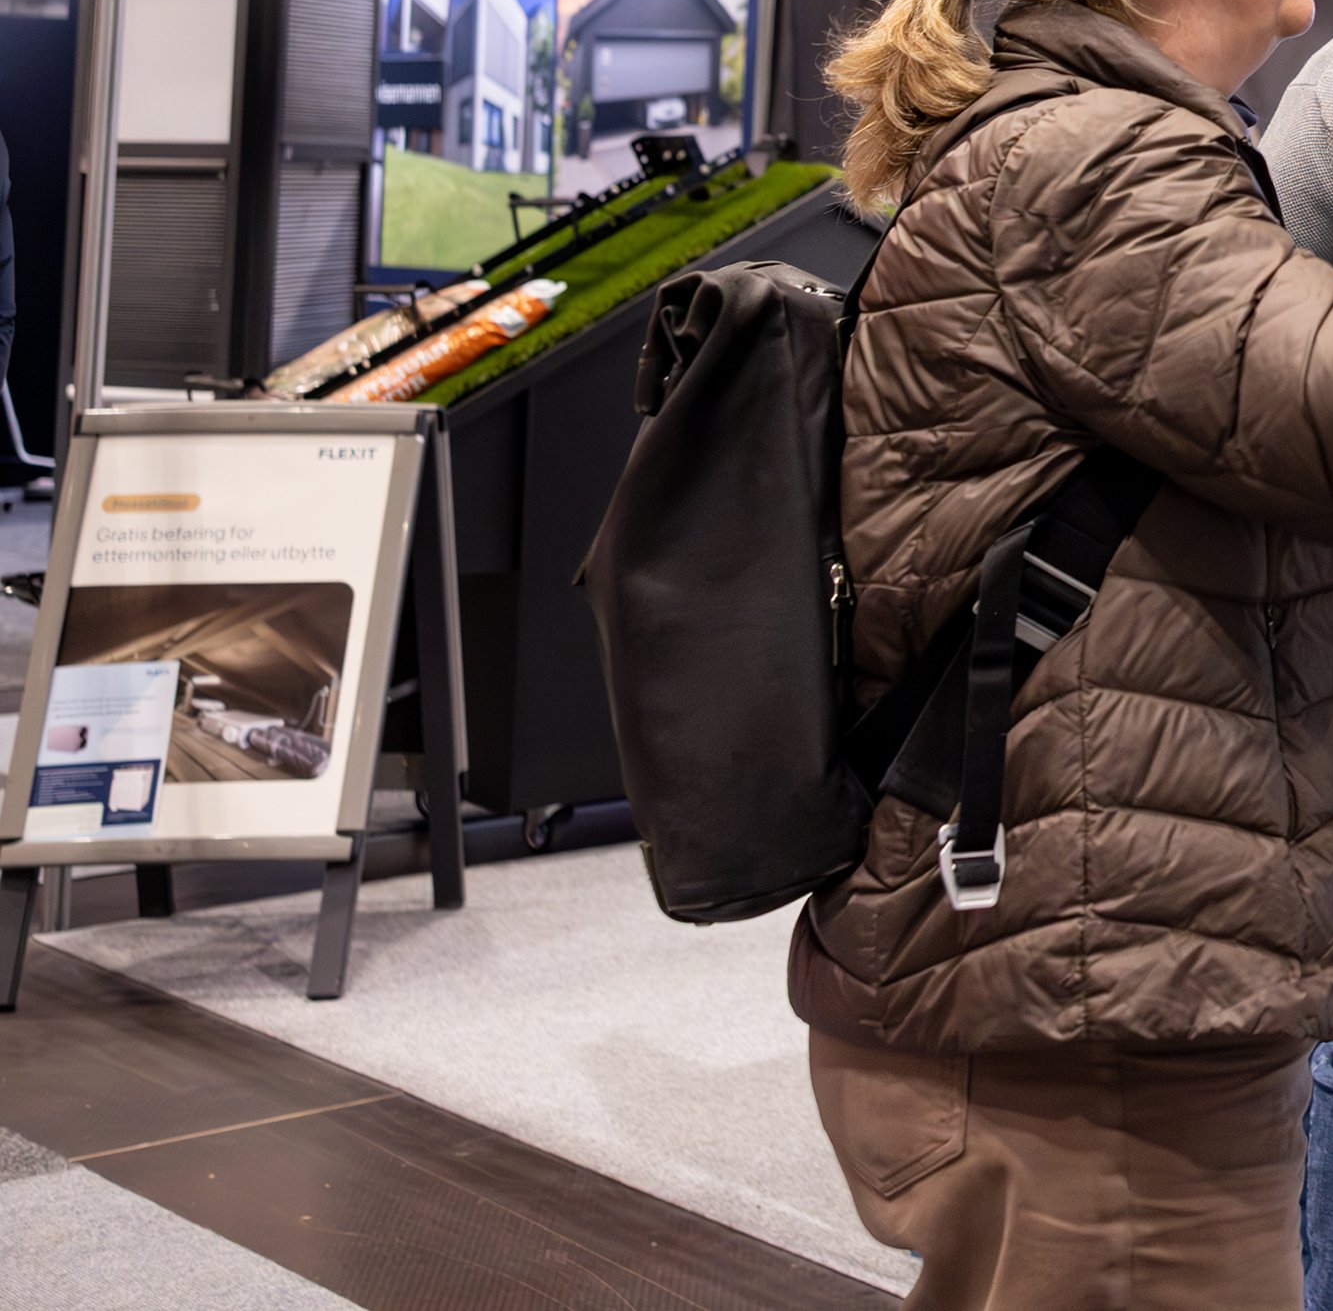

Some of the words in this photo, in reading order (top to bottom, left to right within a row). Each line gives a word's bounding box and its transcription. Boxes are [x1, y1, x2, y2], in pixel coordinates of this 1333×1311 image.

[317, 447, 378, 460] FLEXIT
[152, 525, 226, 545] befaring
[230, 524, 254, 540] for
[271, 545, 336, 565] utbytte
